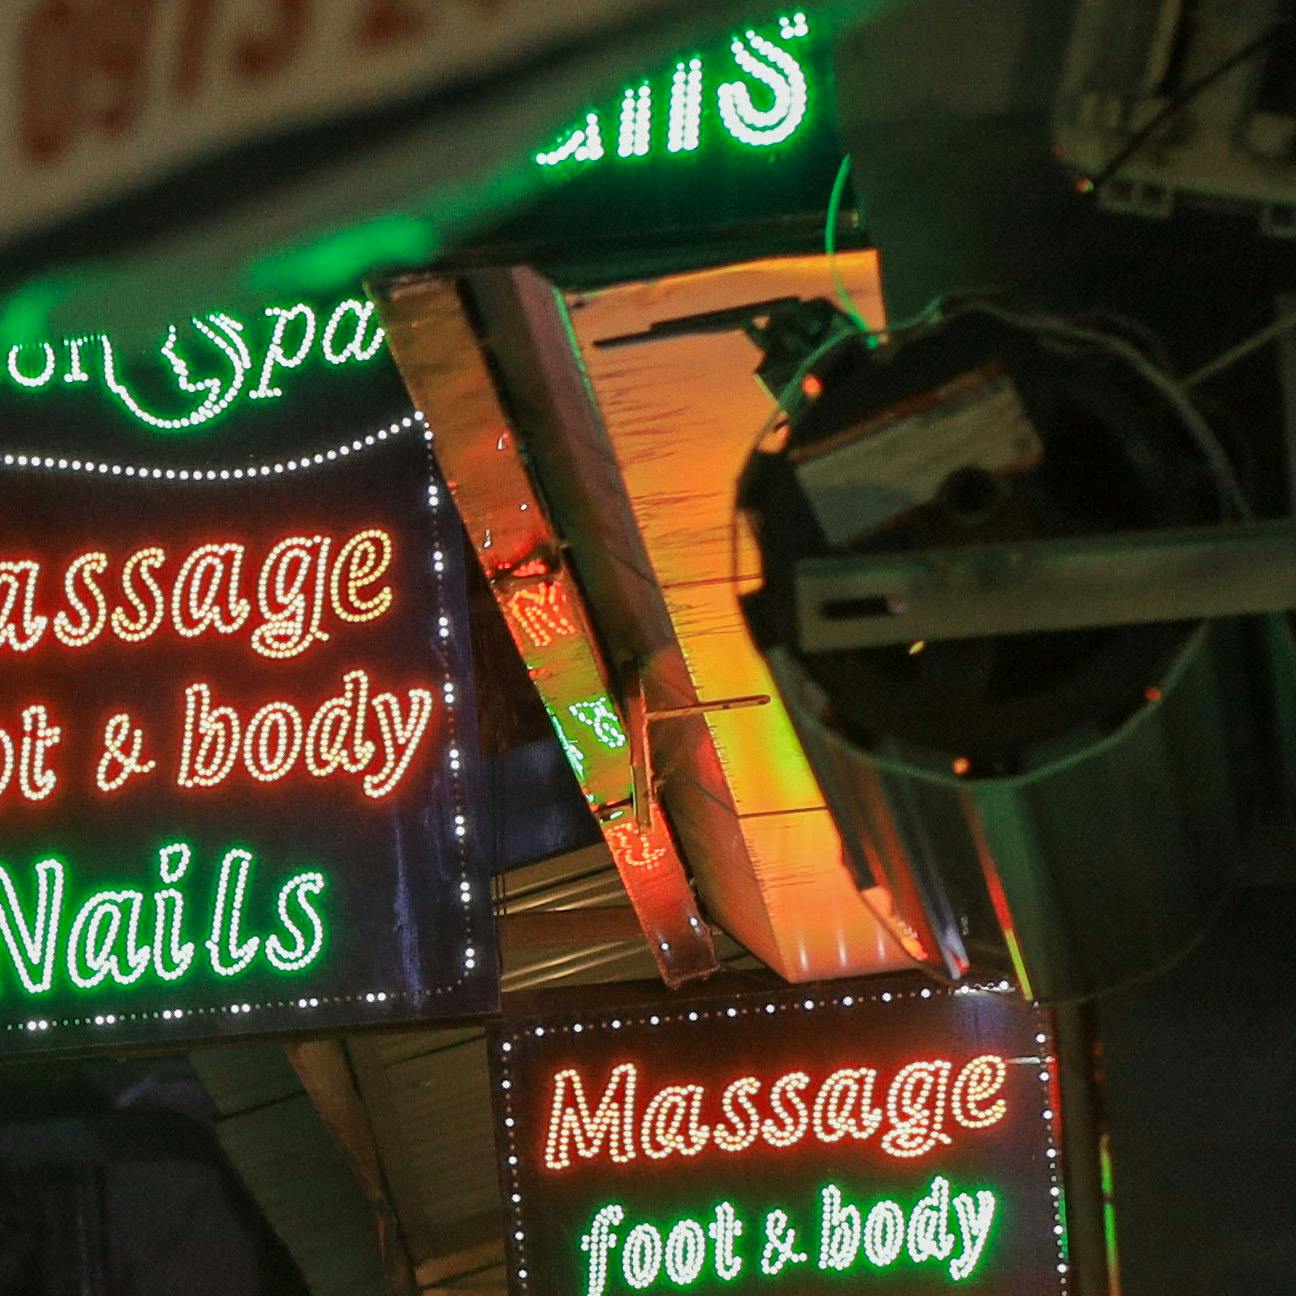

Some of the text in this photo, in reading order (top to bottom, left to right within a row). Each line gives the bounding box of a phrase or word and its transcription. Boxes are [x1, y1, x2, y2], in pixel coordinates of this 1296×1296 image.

[96, 713, 157, 793] &
[177, 670, 433, 800] body
[544, 1054, 1008, 1170] Massage
[759, 1208, 808, 1276] &
[816, 1175, 997, 1282] body
